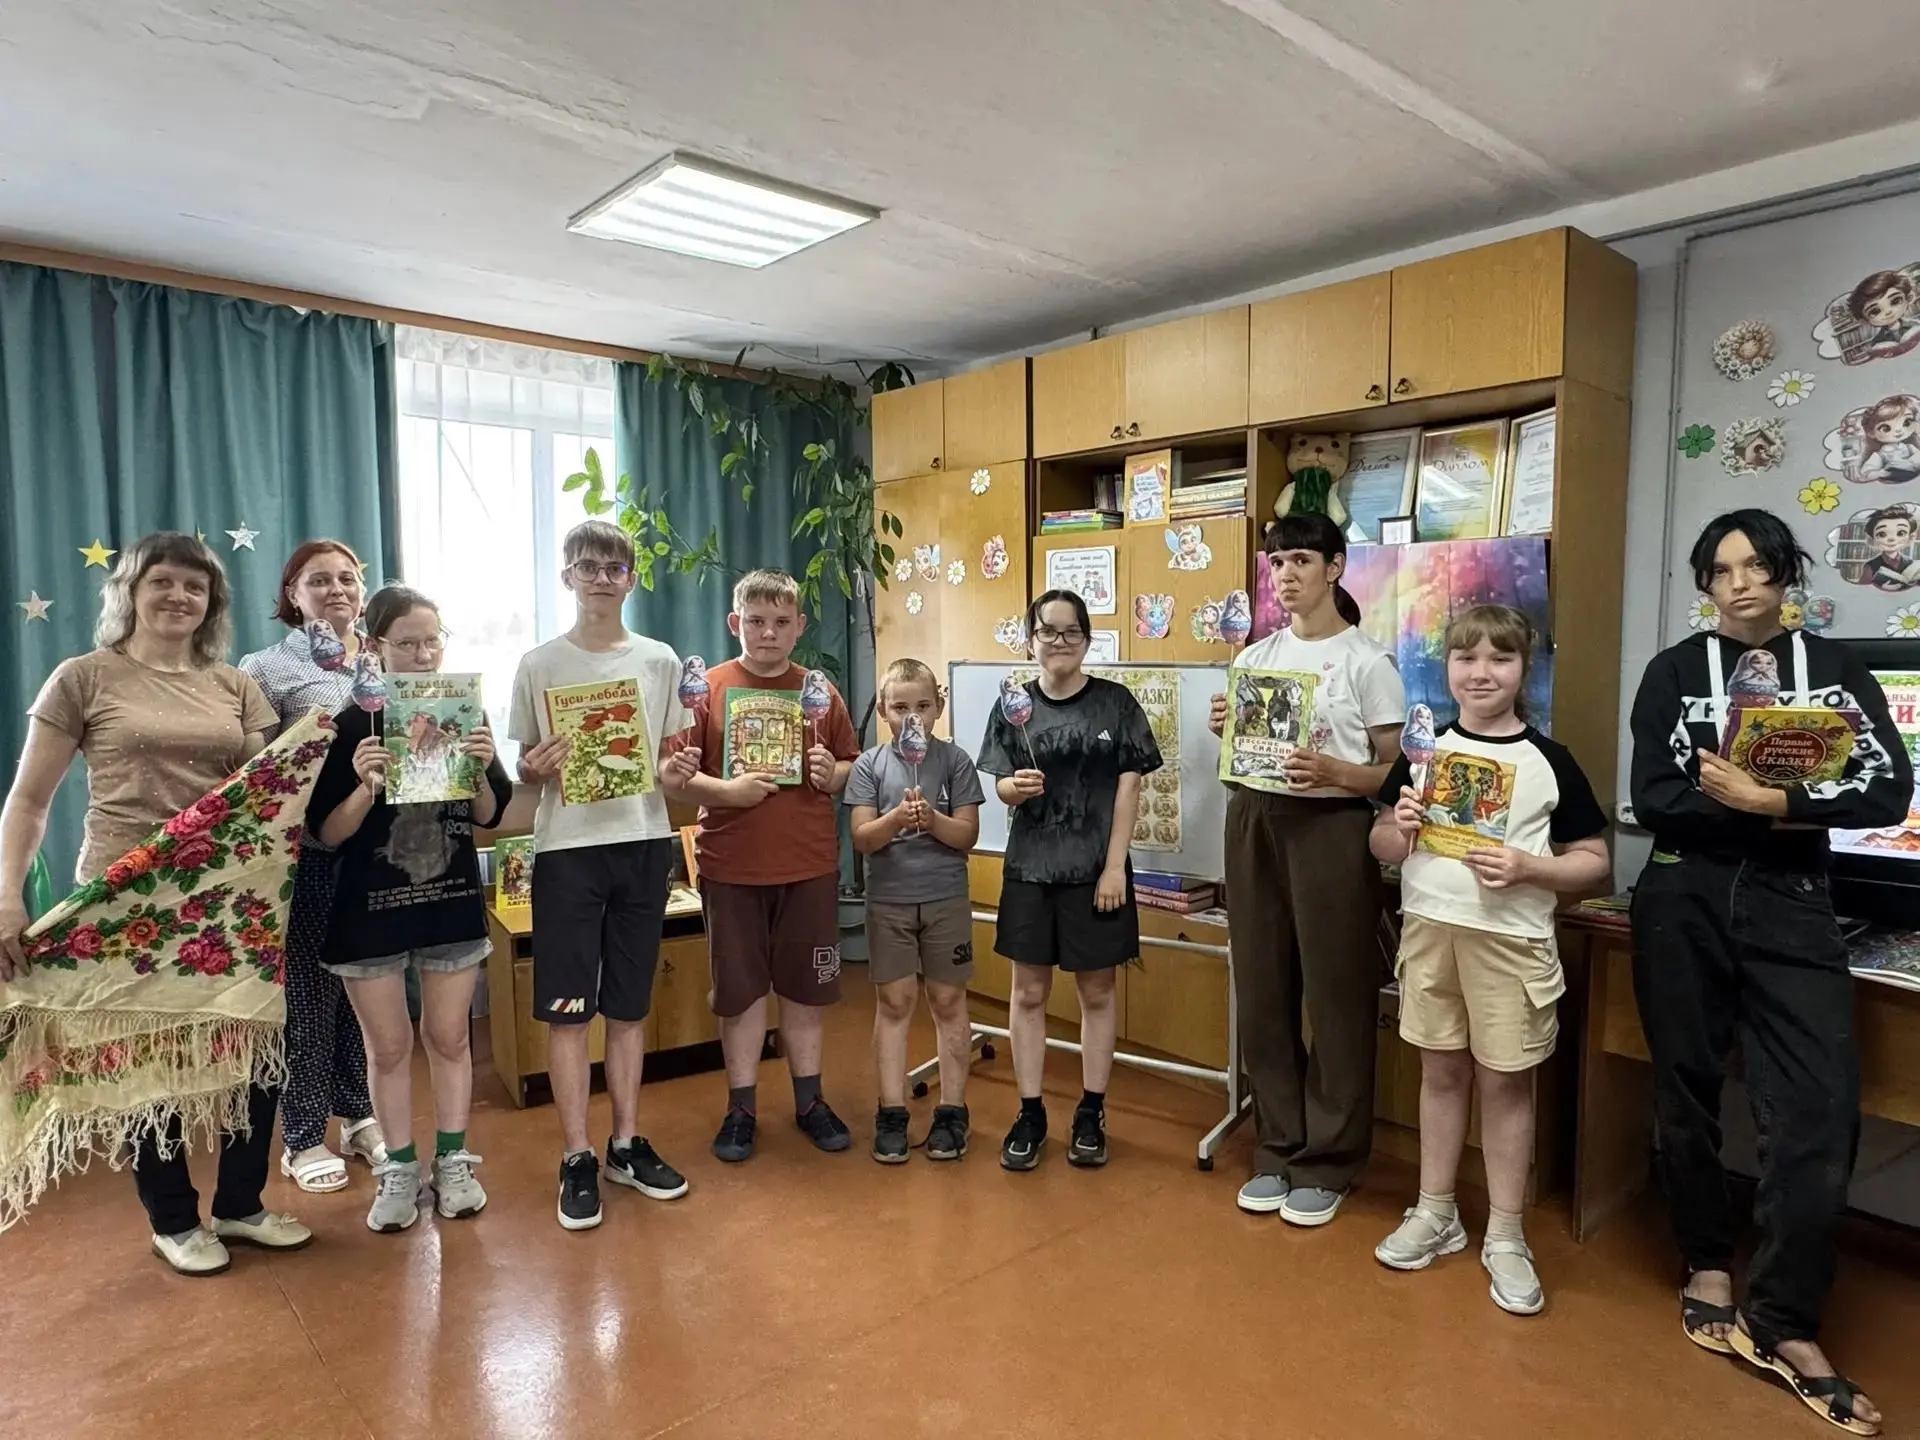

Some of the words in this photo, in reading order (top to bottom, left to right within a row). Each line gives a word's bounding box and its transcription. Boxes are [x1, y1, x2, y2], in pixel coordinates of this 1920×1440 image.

[554, 687, 636, 708] Гуси-лебеди
[1770, 737, 1813, 747] Первые
[1763, 746, 1816, 756] русские
[1756, 755, 1817, 767] Сказки
